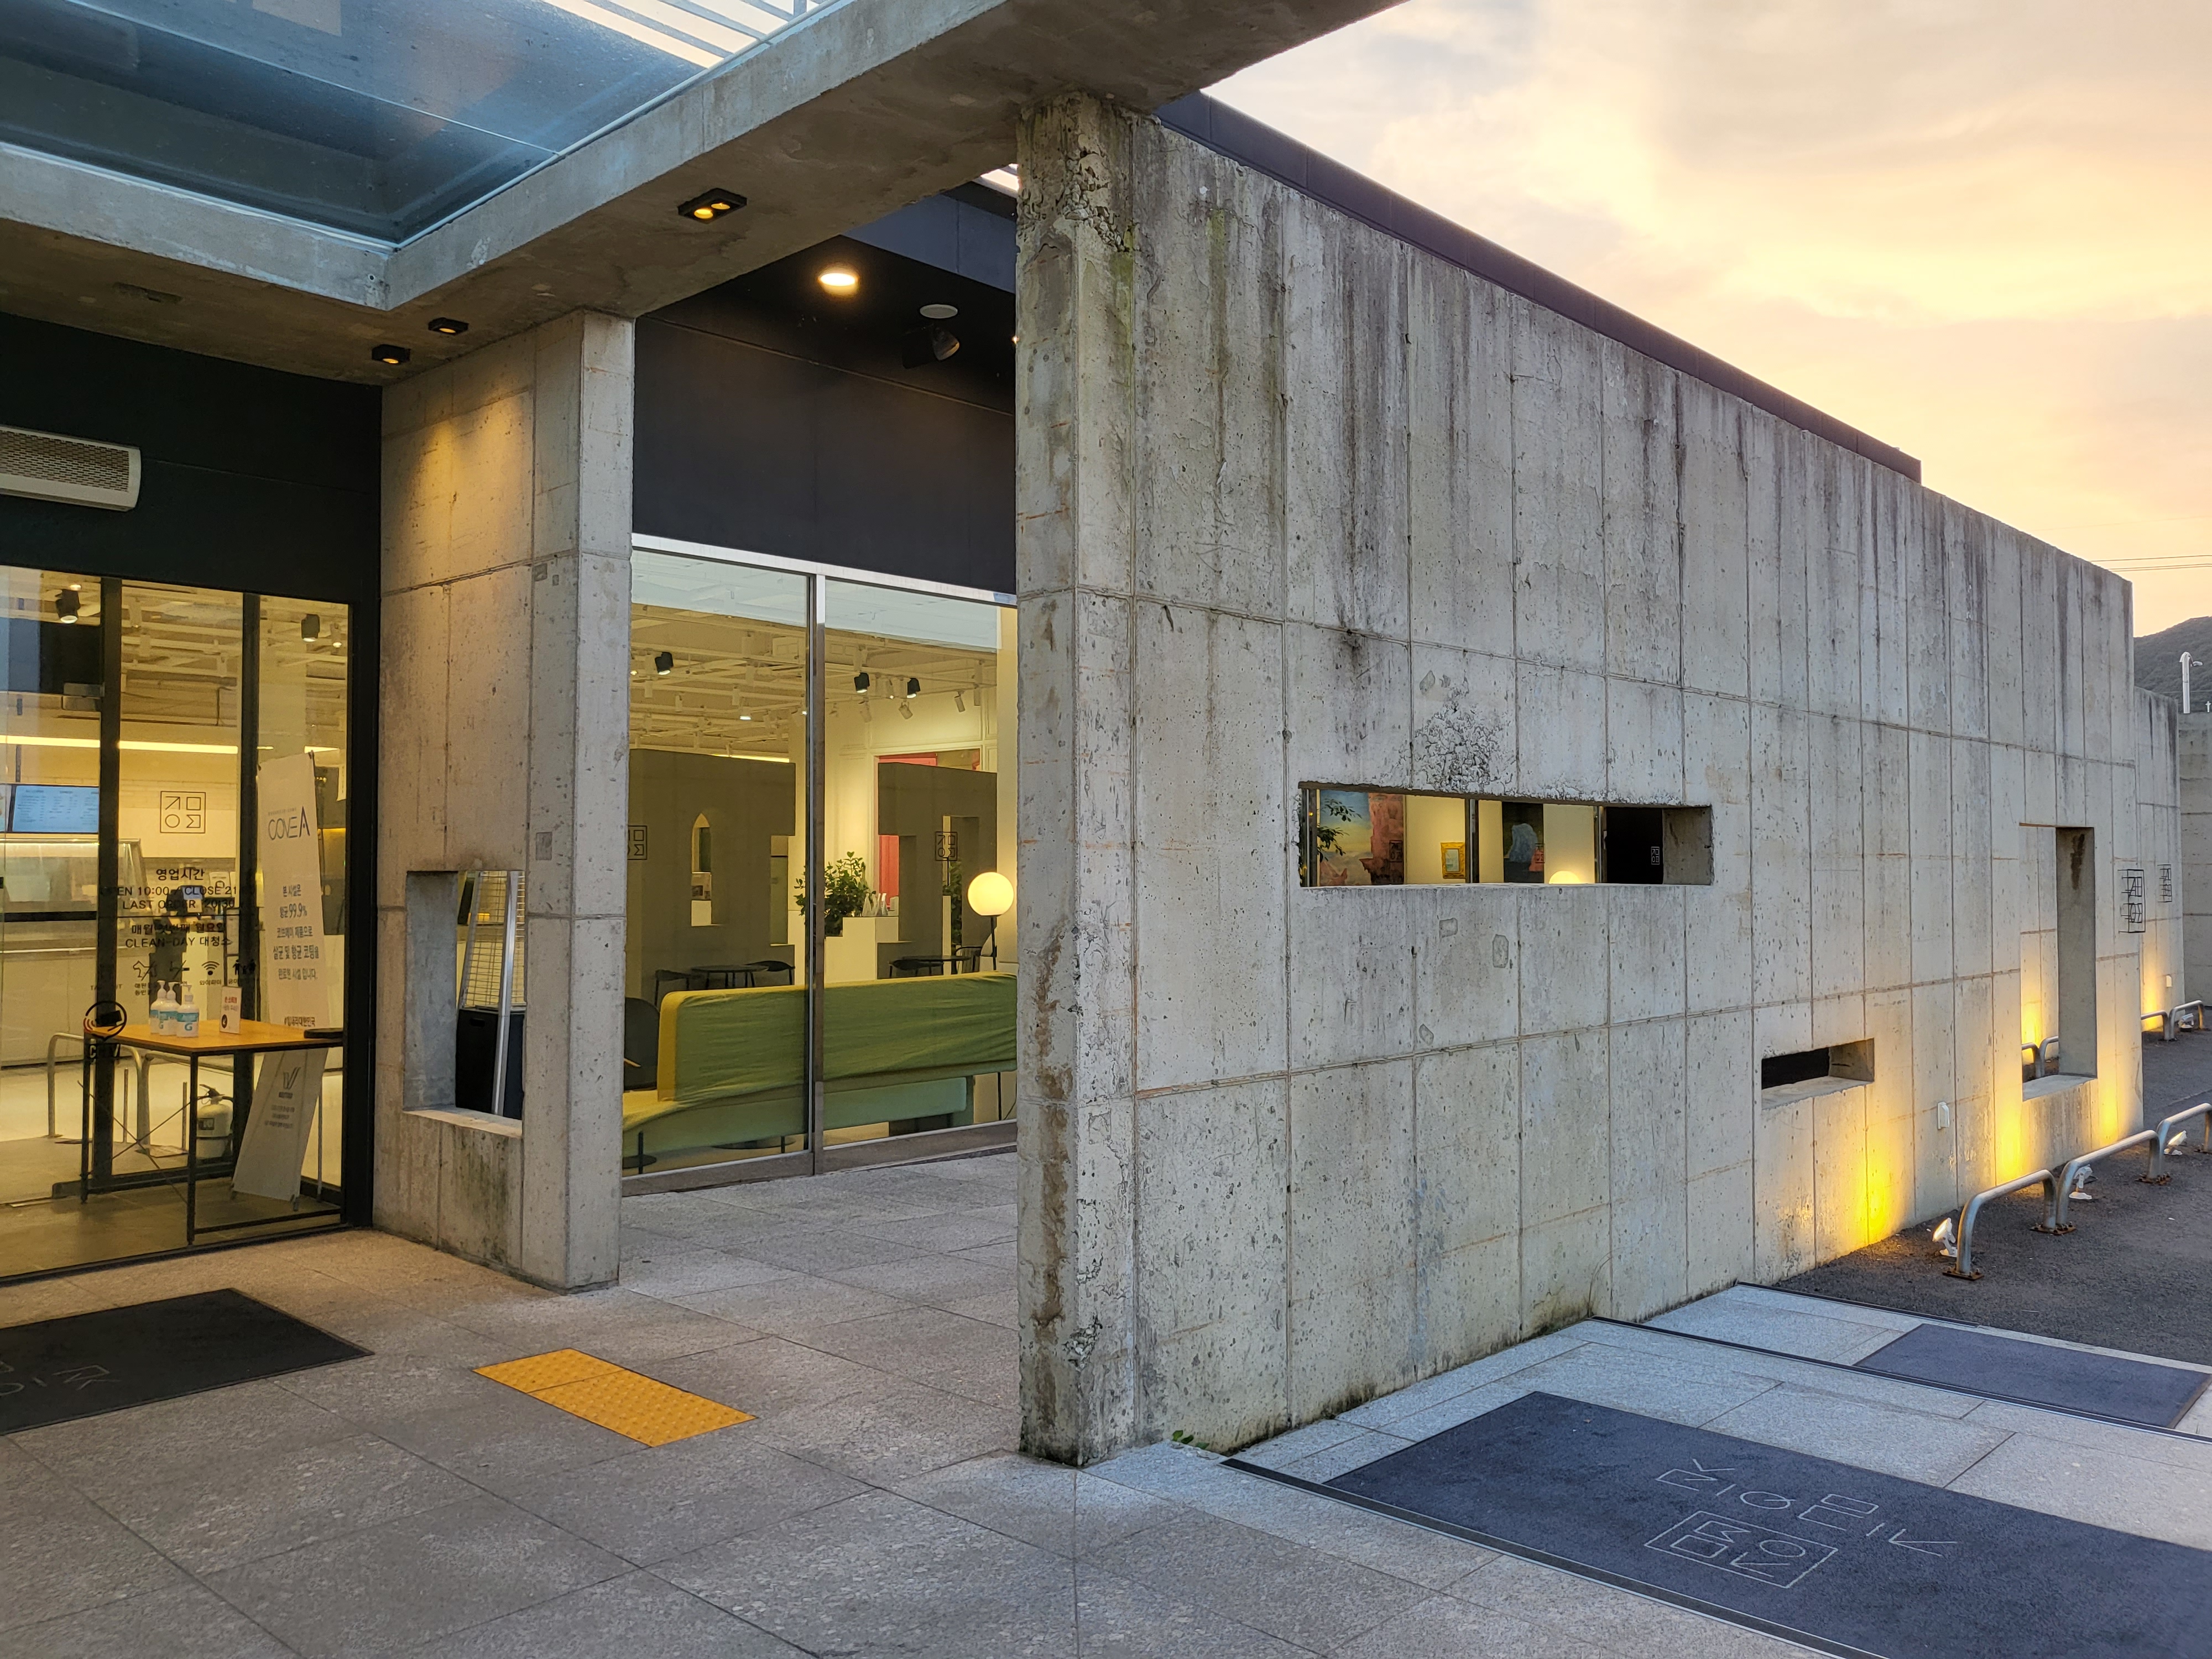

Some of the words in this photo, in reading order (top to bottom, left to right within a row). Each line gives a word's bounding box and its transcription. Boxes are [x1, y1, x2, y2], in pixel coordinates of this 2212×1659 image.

[156, 868, 205, 881] 영업시간
[138, 886, 169, 896] 10:00
[184, 886, 221, 895] CLOSE
[123, 900, 154, 910] LAST
[204, 899, 235, 909] 20:30
[132, 924, 153, 935] 매월
[200, 935, 233, 947] 대청소
